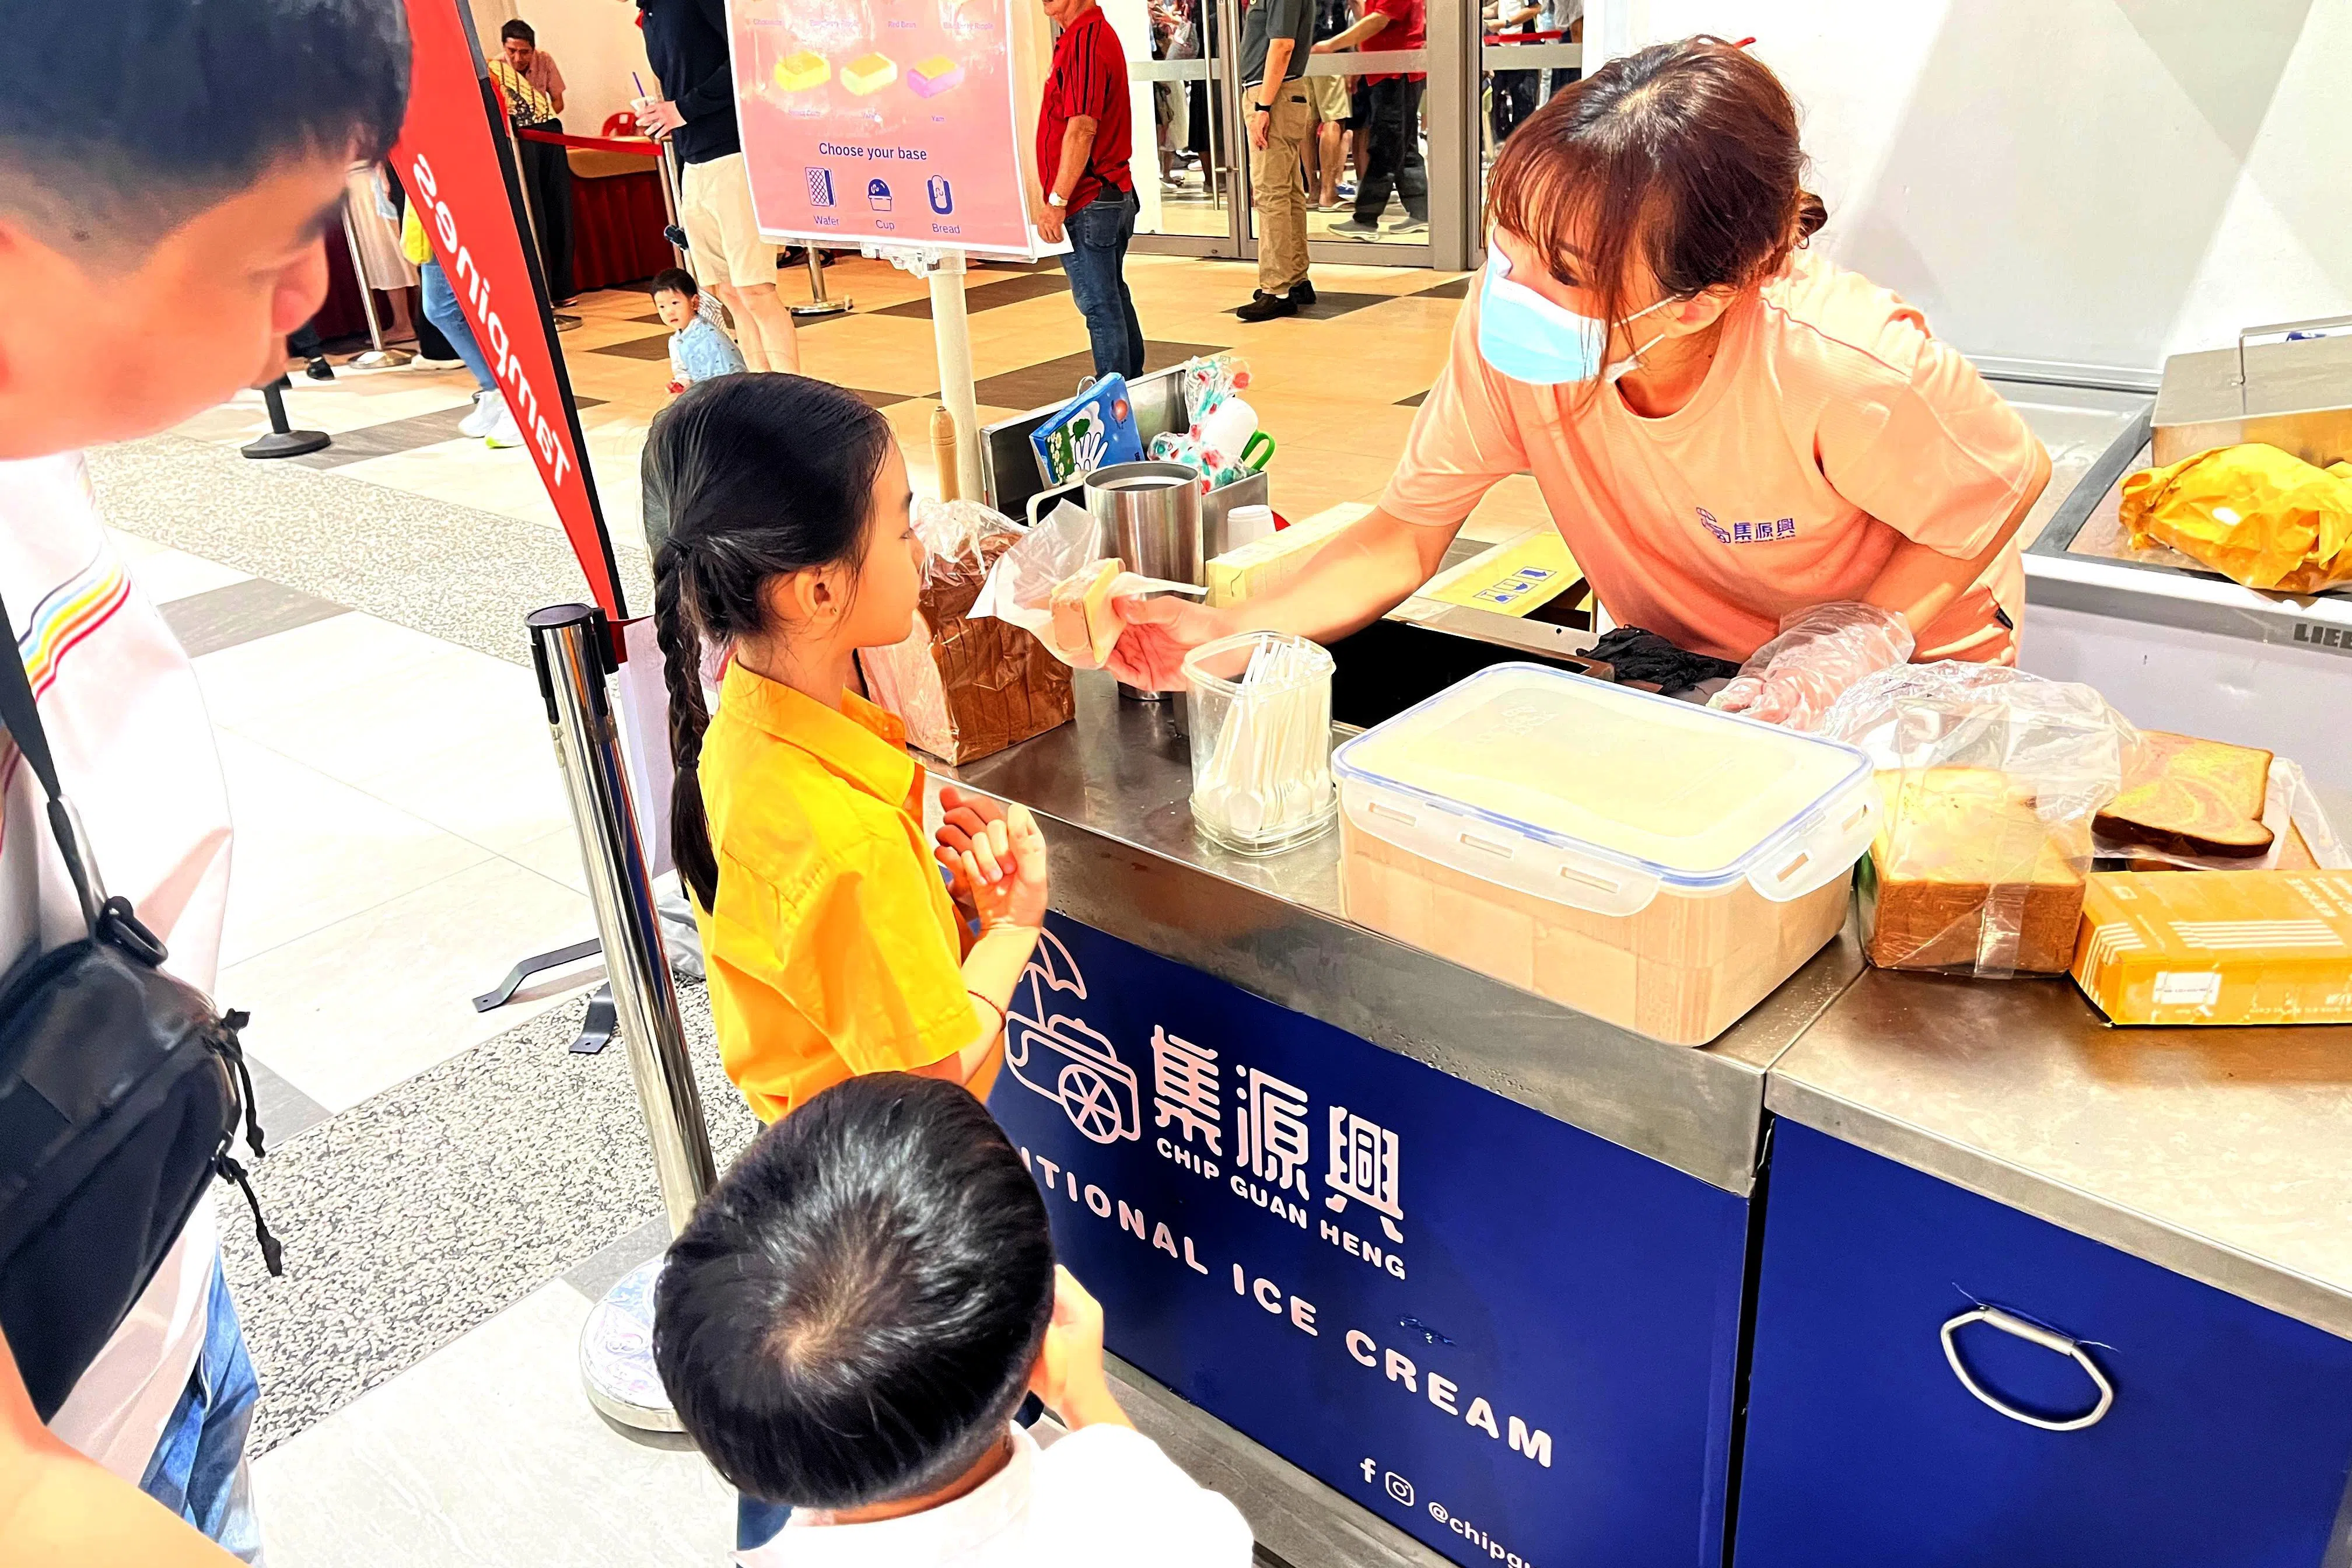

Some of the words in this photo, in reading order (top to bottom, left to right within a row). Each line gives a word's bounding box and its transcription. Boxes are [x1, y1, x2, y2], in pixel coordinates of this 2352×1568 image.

[901, 20, 916, 29] Bean
[819, 142, 863, 156] Choose
[867, 147, 894, 160] your
[898, 146, 927, 160] base
[814, 215, 839, 226] Wafer
[876, 219, 895, 230] Cup
[932, 223, 960, 234] Bread
[1151, 1025, 1403, 1244] 集源興
[1157, 1138, 1219, 1179] CHIP
[1231, 1176, 1307, 1228] GUAN
[1321, 1220, 1405, 1279] HENG
[1021, 1147, 1208, 1274] ITIONAL
[1233, 1264, 1317, 1336] ICE
[1346, 1330, 1551, 1467] CREAM
[1429, 1502, 1531, 1568] @chipg
